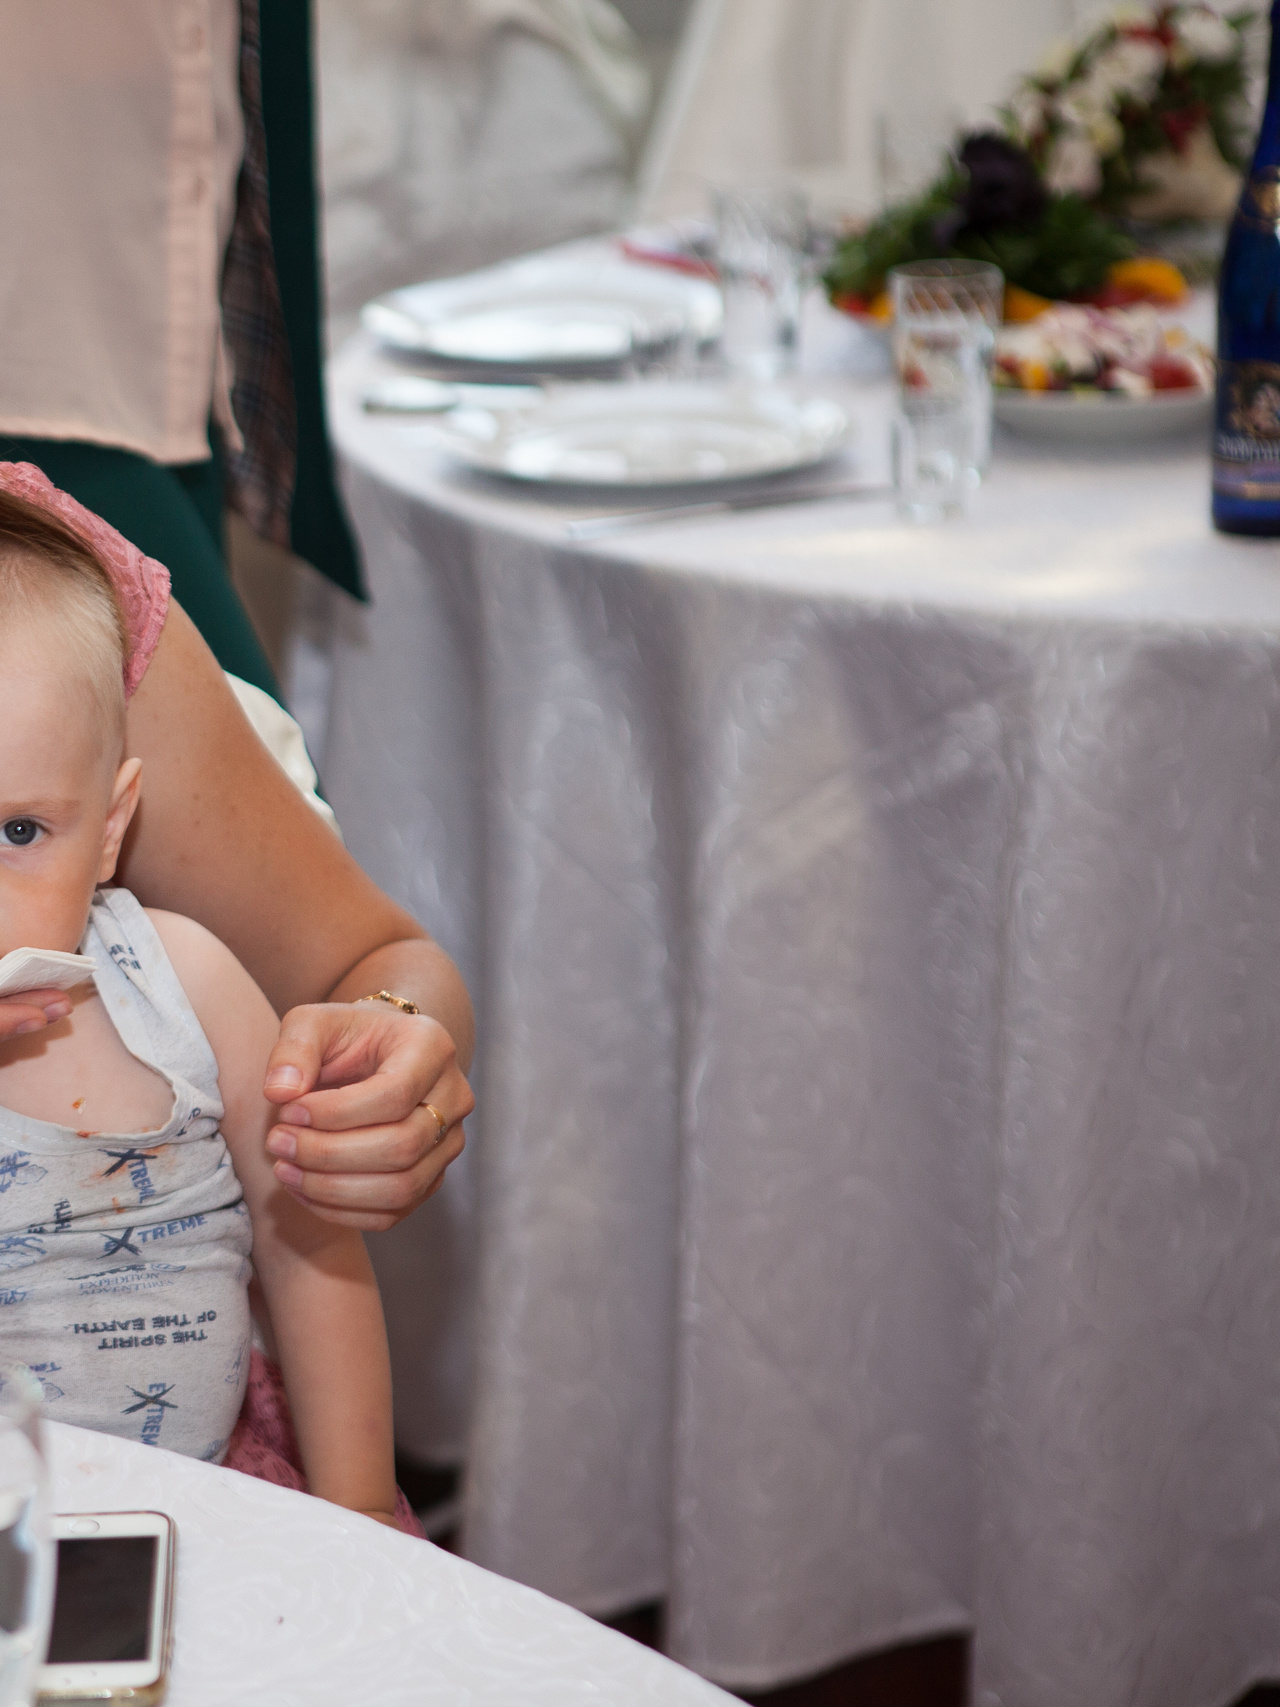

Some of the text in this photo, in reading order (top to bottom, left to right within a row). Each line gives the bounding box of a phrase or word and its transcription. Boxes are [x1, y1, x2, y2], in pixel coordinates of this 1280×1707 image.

[79, 1272, 160, 1290] EXPEDITION
[80, 1280, 175, 1296] ADVENTURES
[73, 1309, 217, 1334] OF THE EARTH
[97, 1329, 208, 1350] THE SPIRIT
